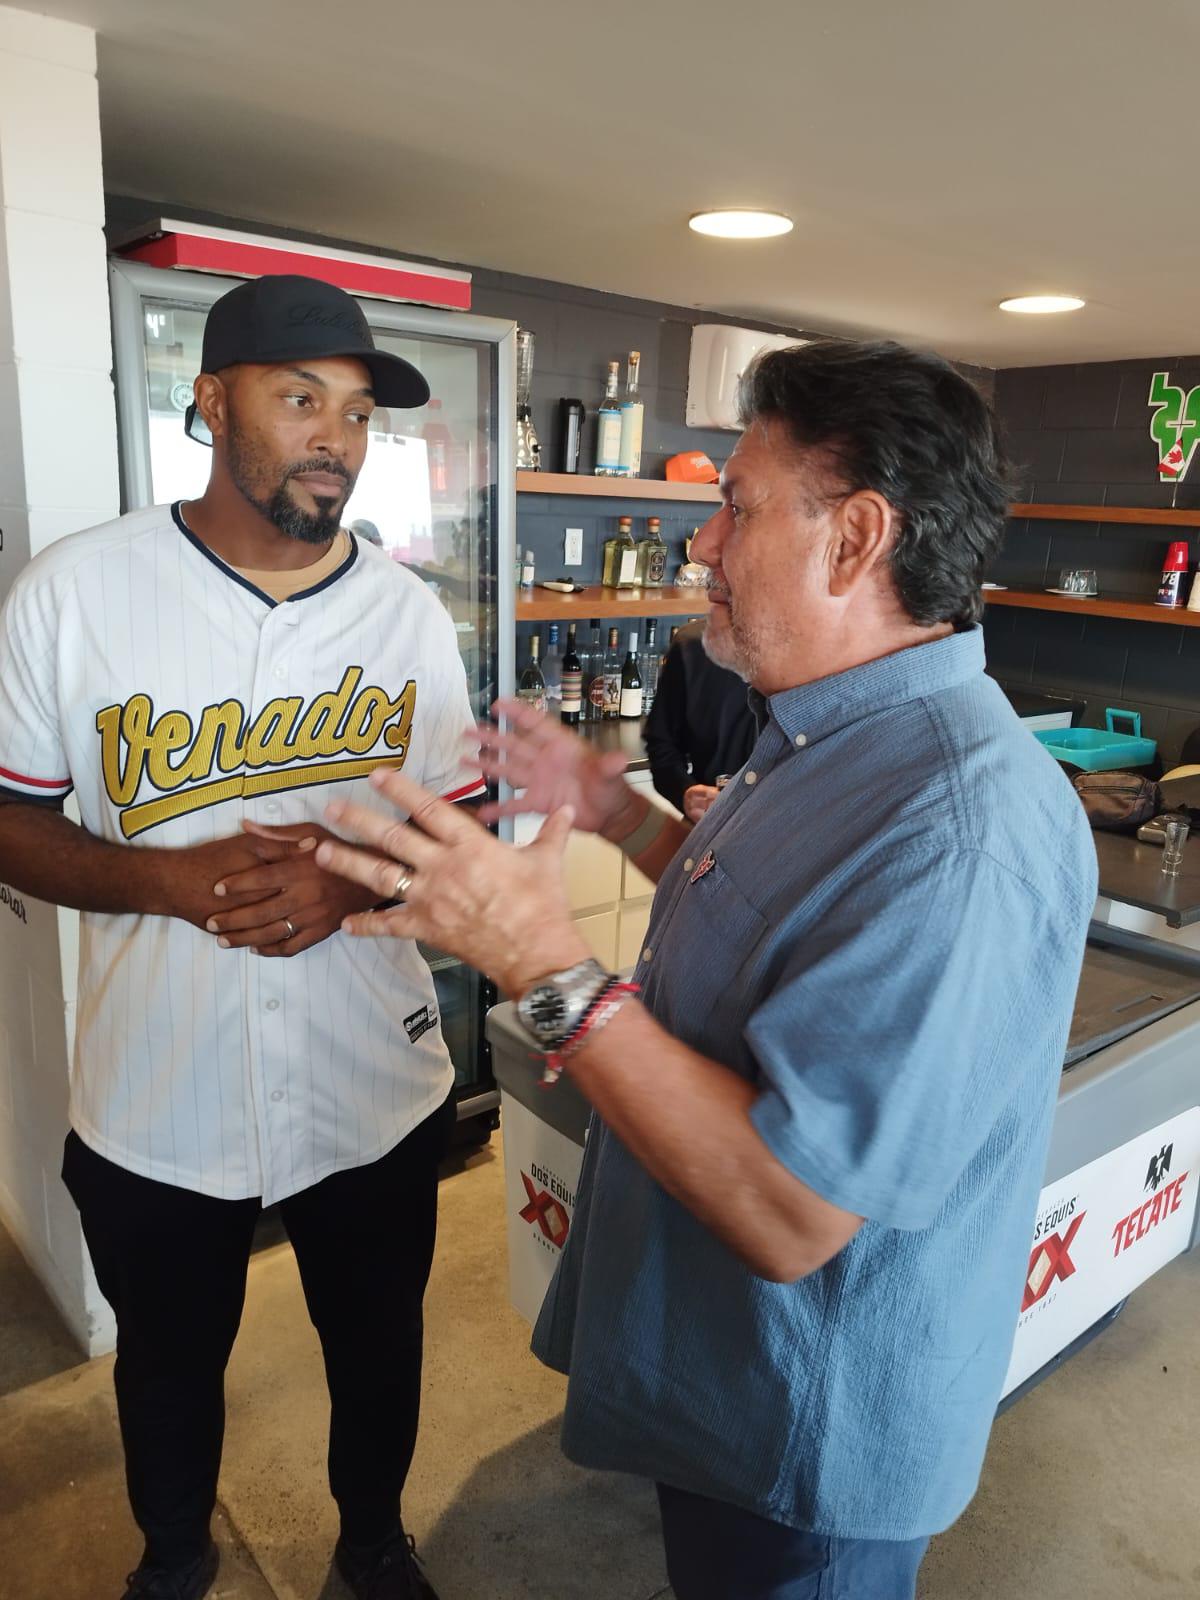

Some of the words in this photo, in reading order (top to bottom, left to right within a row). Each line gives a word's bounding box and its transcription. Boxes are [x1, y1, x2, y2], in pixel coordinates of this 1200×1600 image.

[97, 666, 416, 806] Venados
[531, 1162, 549, 1187] DOS
[1044, 1197, 1076, 1233] EQUIS
[1111, 1170, 1190, 1258] TECATE
